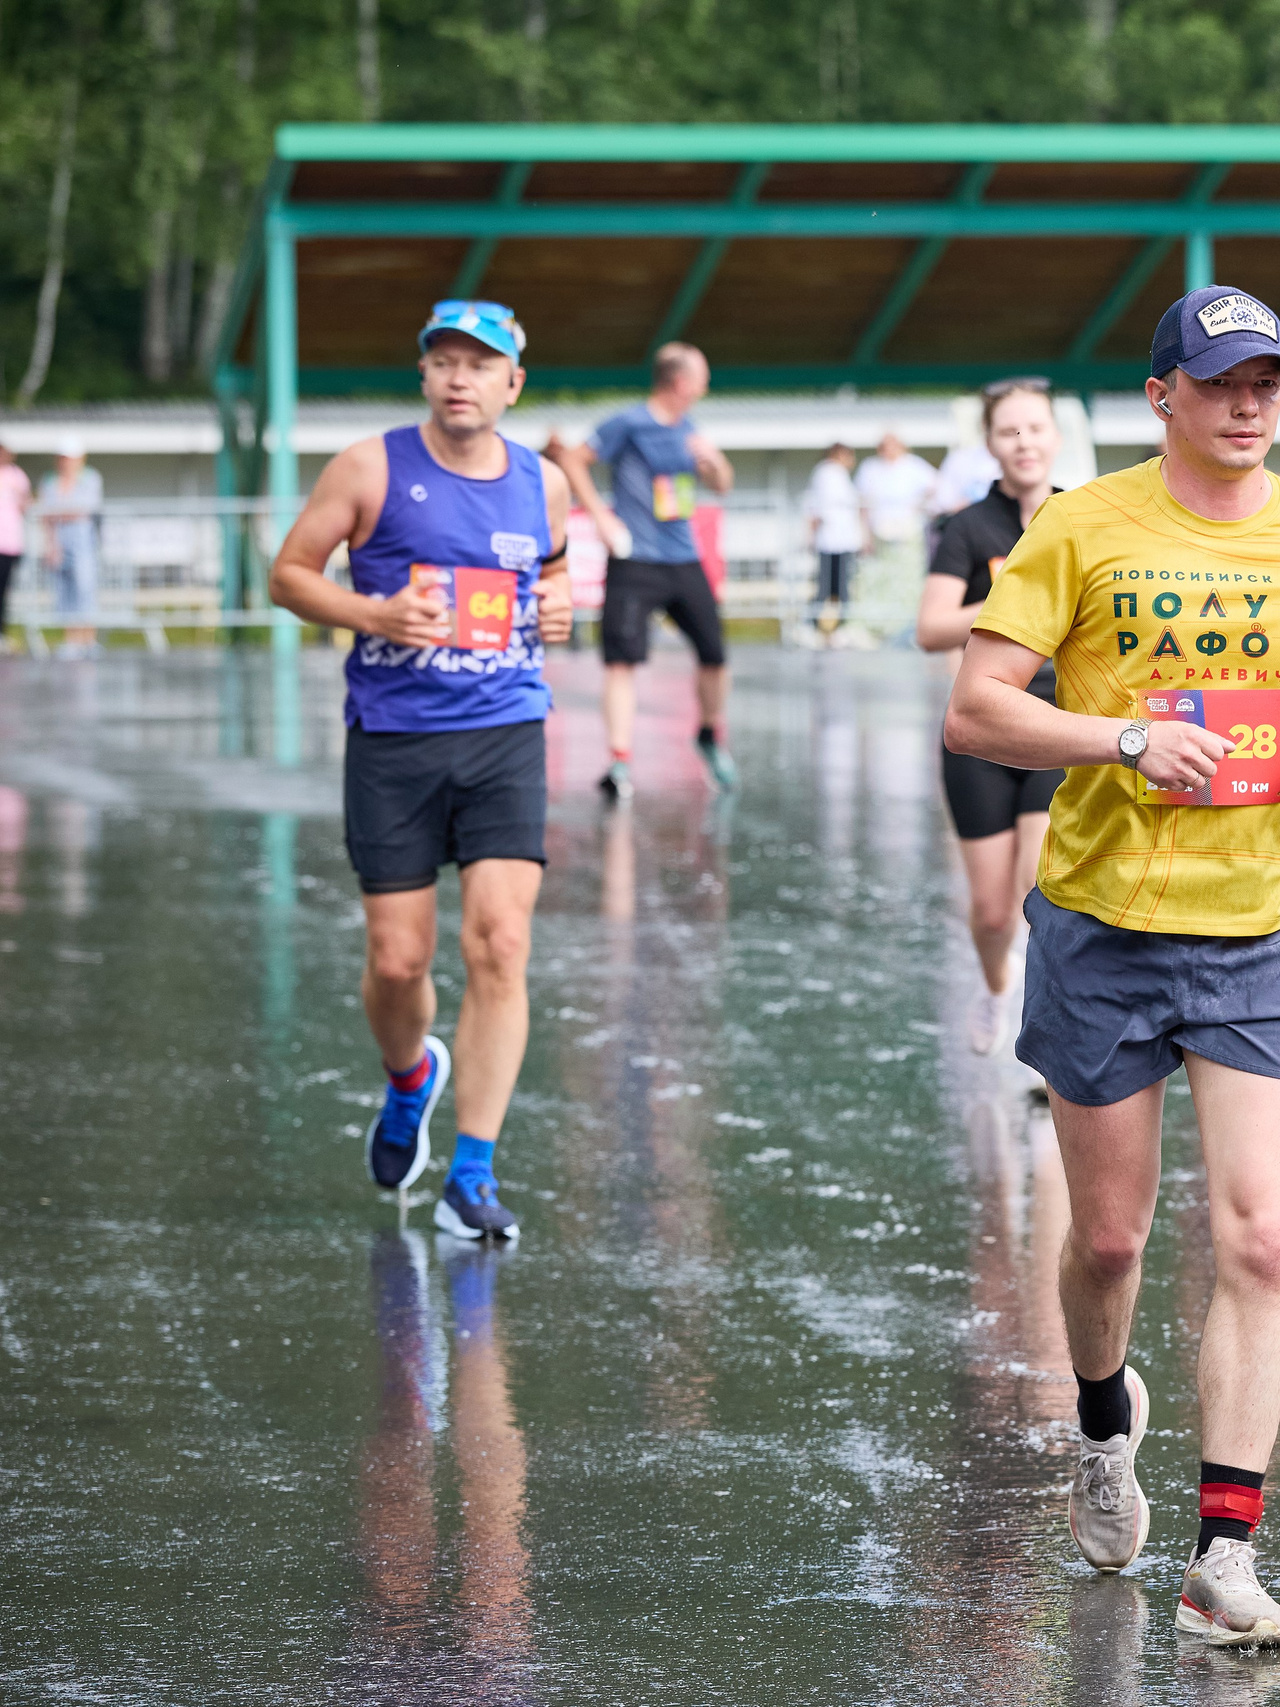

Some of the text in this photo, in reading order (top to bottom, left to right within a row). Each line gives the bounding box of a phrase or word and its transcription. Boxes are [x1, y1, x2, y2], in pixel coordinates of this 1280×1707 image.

[1202, 299, 1231, 318] SIBIR
[1235, 297, 1272, 322] HOCKEY
[1113, 570, 1272, 583] НОВОСИБИРСК
[468, 591, 508, 620] 64
[1150, 668, 1173, 680] А.
[1228, 724, 1277, 759] 28
[1231, 780, 1248, 793] 10
